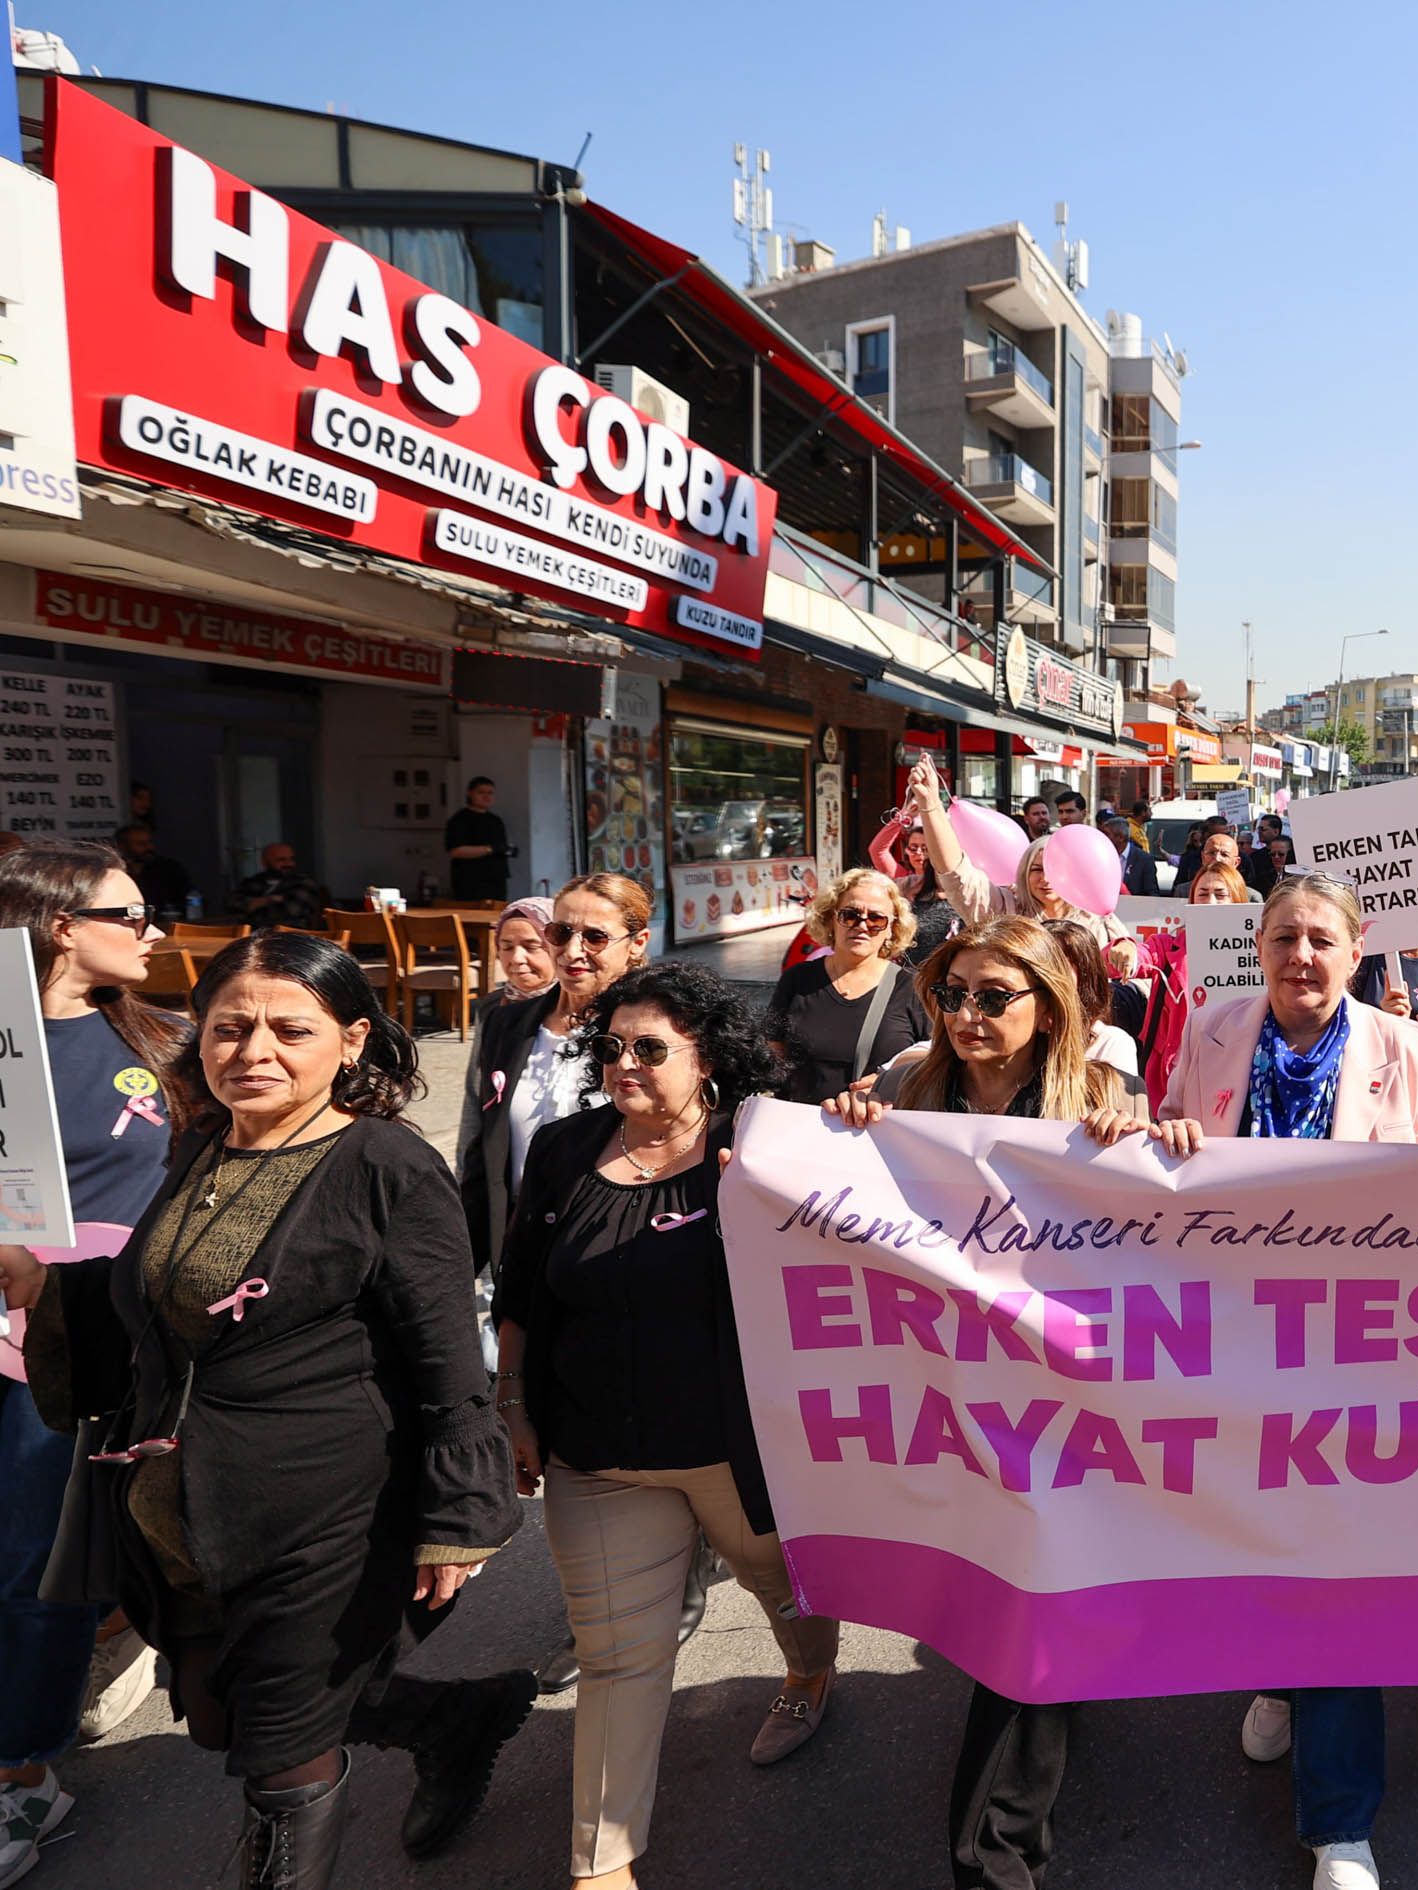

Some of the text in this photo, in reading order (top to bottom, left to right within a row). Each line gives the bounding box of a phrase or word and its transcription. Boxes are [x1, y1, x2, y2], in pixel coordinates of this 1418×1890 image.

[171, 144, 760, 557] HAS ÇORBA
[138, 415, 367, 515] OĞLAK KEBABI
[0, 463, 75, 504] ress
[327, 407, 713, 586] ÇORBANIN HASI KENDİ SUYUNDA
[446, 522, 644, 605] SULU YEMEK ÇEŞİTLERİ
[46, 587, 160, 631] SULU
[174, 607, 296, 654] YEMEK
[686, 605, 758, 643] KUZU TANDIR
[1, 675, 48, 693] KELLE
[65, 683, 105, 698] AYAK
[33, 702, 51, 717] TL
[64, 704, 111, 722] 220 TL
[36, 748, 55, 763] TL
[96, 749, 113, 763] TL
[38, 791, 57, 806] TL
[98, 796, 117, 810] TL
[1312, 834, 1383, 863] ERKEN
[1345, 858, 1413, 886] HAYAT
[1244, 918, 1254, 931] 8
[1209, 937, 1258, 951] KADIN
[1203, 971, 1265, 988] OLABİLİ
[776, 1186, 952, 1249] Meme
[957, 1195, 1164, 1254] Kanseri
[781, 1264, 1212, 1382] ERKEN
[797, 1384, 1218, 1494] HAYAT
